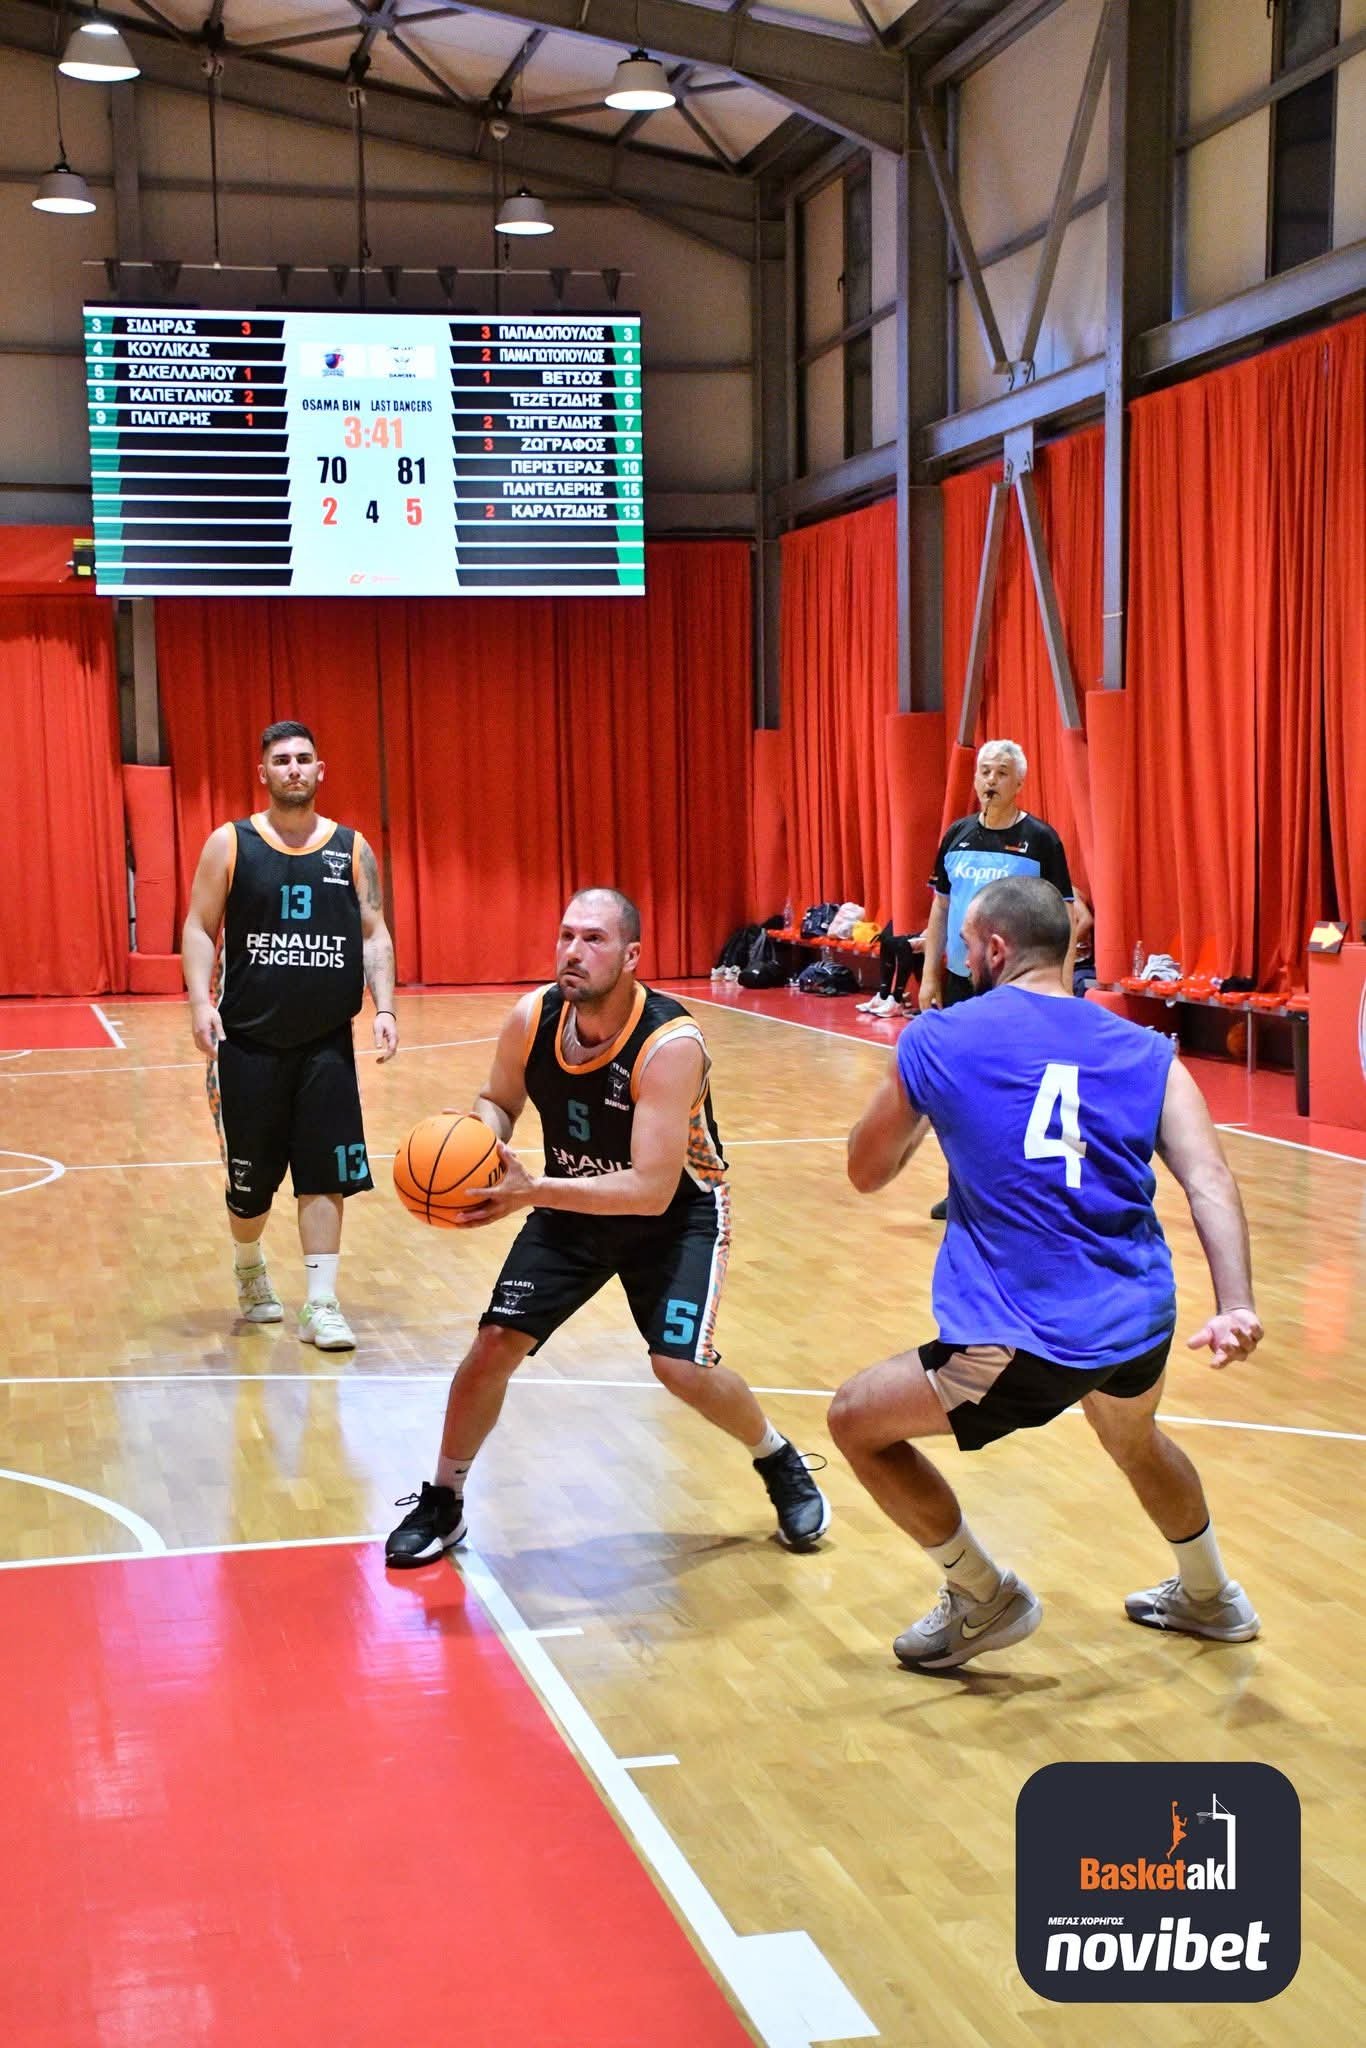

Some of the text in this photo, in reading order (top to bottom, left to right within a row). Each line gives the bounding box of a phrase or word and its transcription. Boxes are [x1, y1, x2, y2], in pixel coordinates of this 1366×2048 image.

[92, 319, 252, 334] 3 ΣΙΔΗΡΑΣ 3
[481, 326, 490, 338] 3
[623, 328, 632, 341] 3
[93, 342, 210, 358] 4 ΚΟΥΛΙΚΑΣ
[481, 348, 491, 361] 2
[623, 350, 633, 363] 4
[94, 365, 252, 380] 5 ΣΑΚΕΛΛΑΡΙΟΥ 1
[483, 371, 490, 383] 1
[624, 372, 633, 386] 5
[95, 388, 253, 403] 8 ΚΑΠΕΤΑΝΙΟΣ 2
[624, 395, 634, 408] 6
[302, 399, 361, 411] OSAMA BIN
[371, 400, 432, 412] LAST DANCERS
[96, 411, 106, 424] 9
[245, 414, 253, 426] 1
[483, 416, 493, 428] 2
[625, 418, 634, 430] 7
[344, 416, 403, 448] 3:41
[484, 438, 493, 450] 3
[625, 439, 634, 452] 9
[317, 457, 426, 484] 70 81
[622, 461, 639, 474] 10
[622, 483, 639, 496] 15
[322, 497, 422, 525] 2 4 5
[486, 505, 495, 517] 2
[623, 505, 640, 518] 13
[280, 884, 312, 920] 13
[246, 933, 346, 951] RENAULT
[249, 949, 345, 968] TSIGELIDIS
[568, 1099, 592, 1142] 5
[1024, 1063, 1088, 1188] 4
[335, 1144, 367, 1182] 13
[663, 1299, 698, 1344] 5
